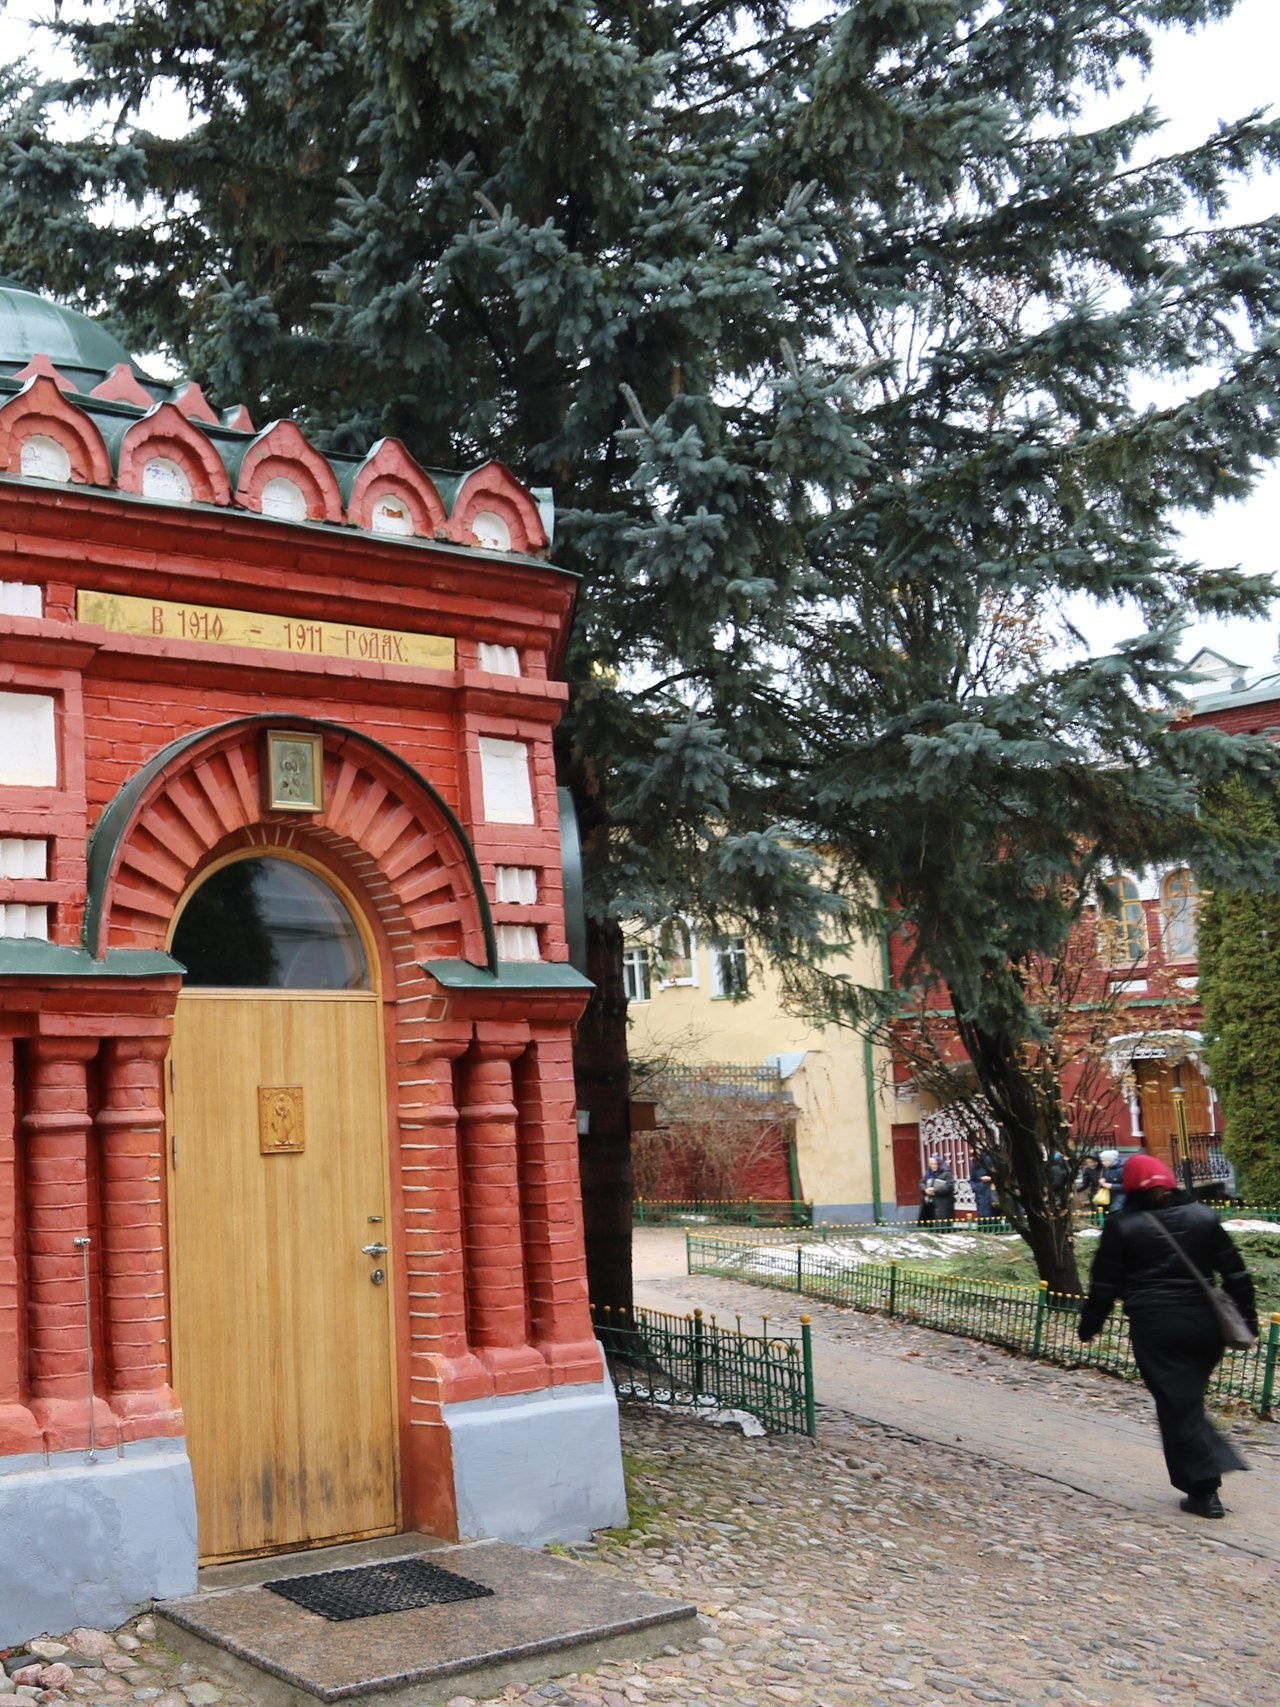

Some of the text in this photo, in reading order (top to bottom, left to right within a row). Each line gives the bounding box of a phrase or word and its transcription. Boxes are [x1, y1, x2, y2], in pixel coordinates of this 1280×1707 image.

[152, 606, 164, 634] В
[177, 609, 223, 640] 1910
[283, 623, 322, 653] 1911
